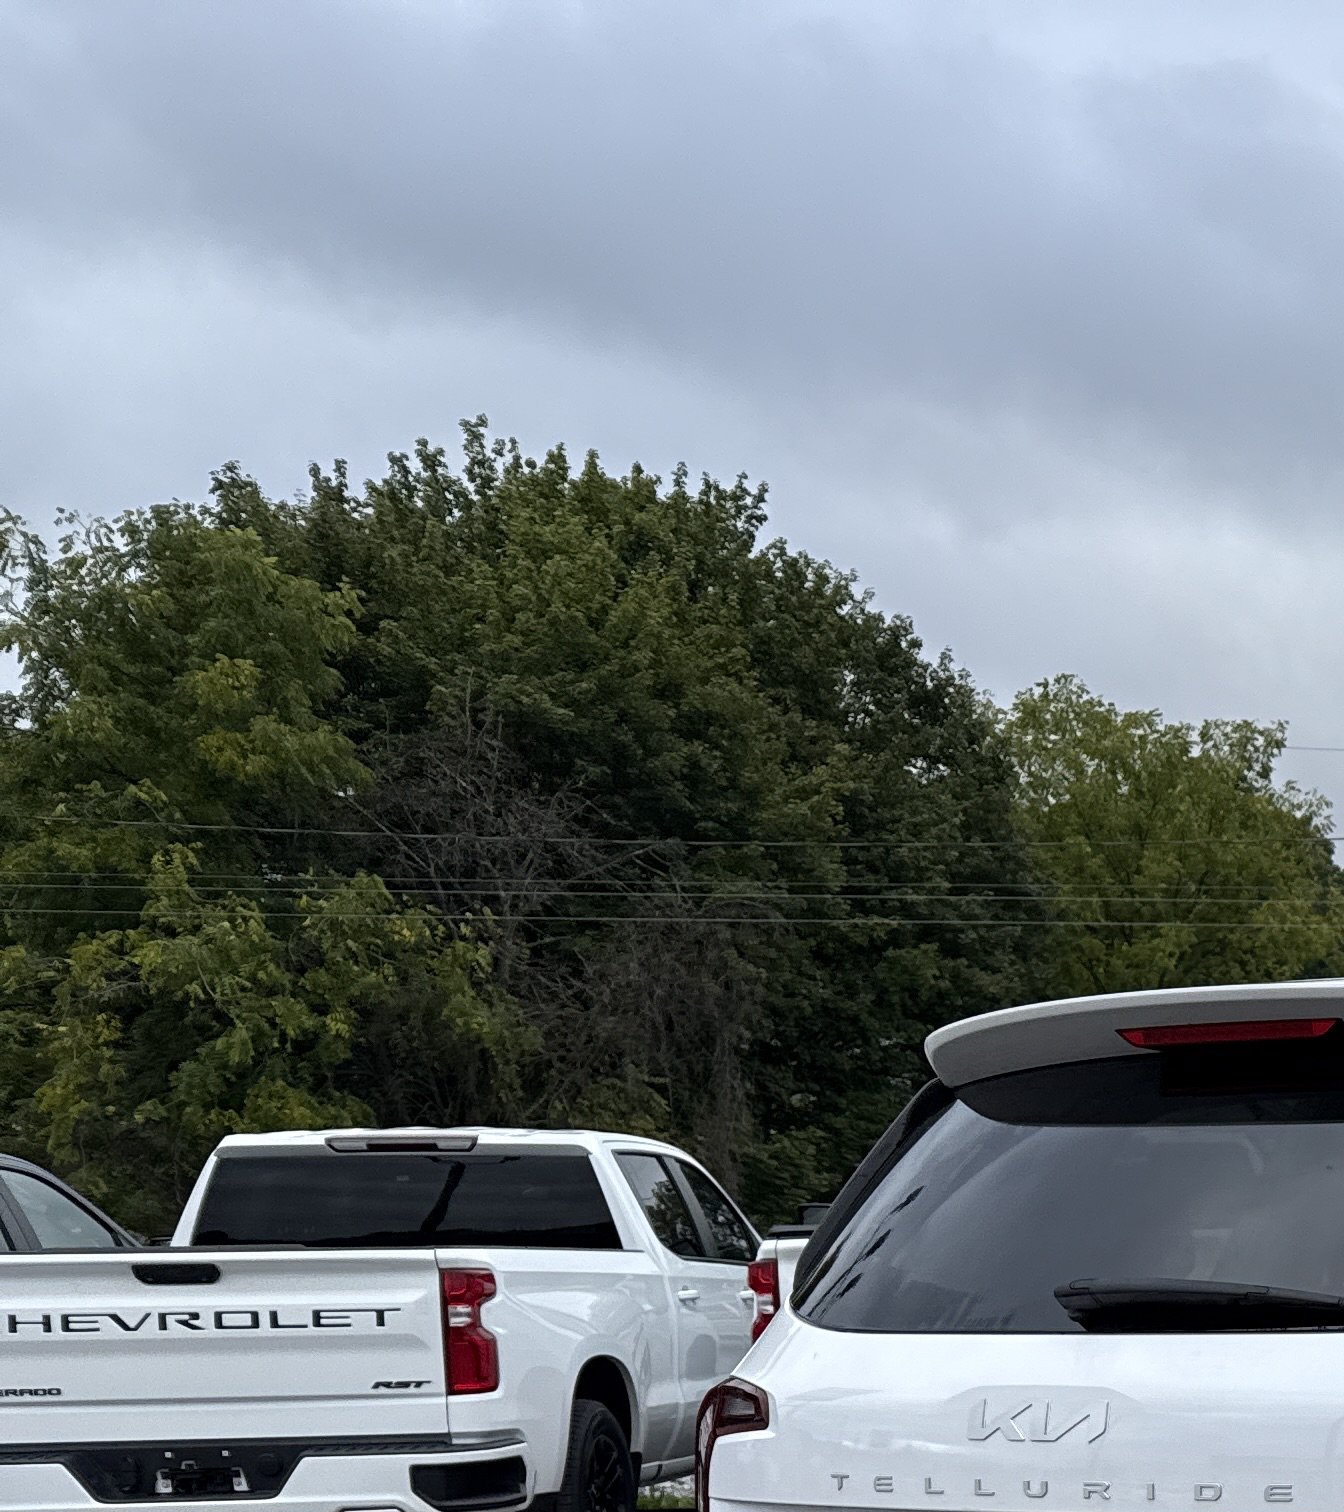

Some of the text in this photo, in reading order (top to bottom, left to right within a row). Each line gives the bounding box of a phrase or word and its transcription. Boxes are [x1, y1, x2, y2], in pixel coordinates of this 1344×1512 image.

[0, 1387, 62, 1397] RADO
[371, 1380, 432, 1389] RST
[967, 1399, 1111, 1445] KIA
[830, 1473, 1294, 1502] TELLURIDE
